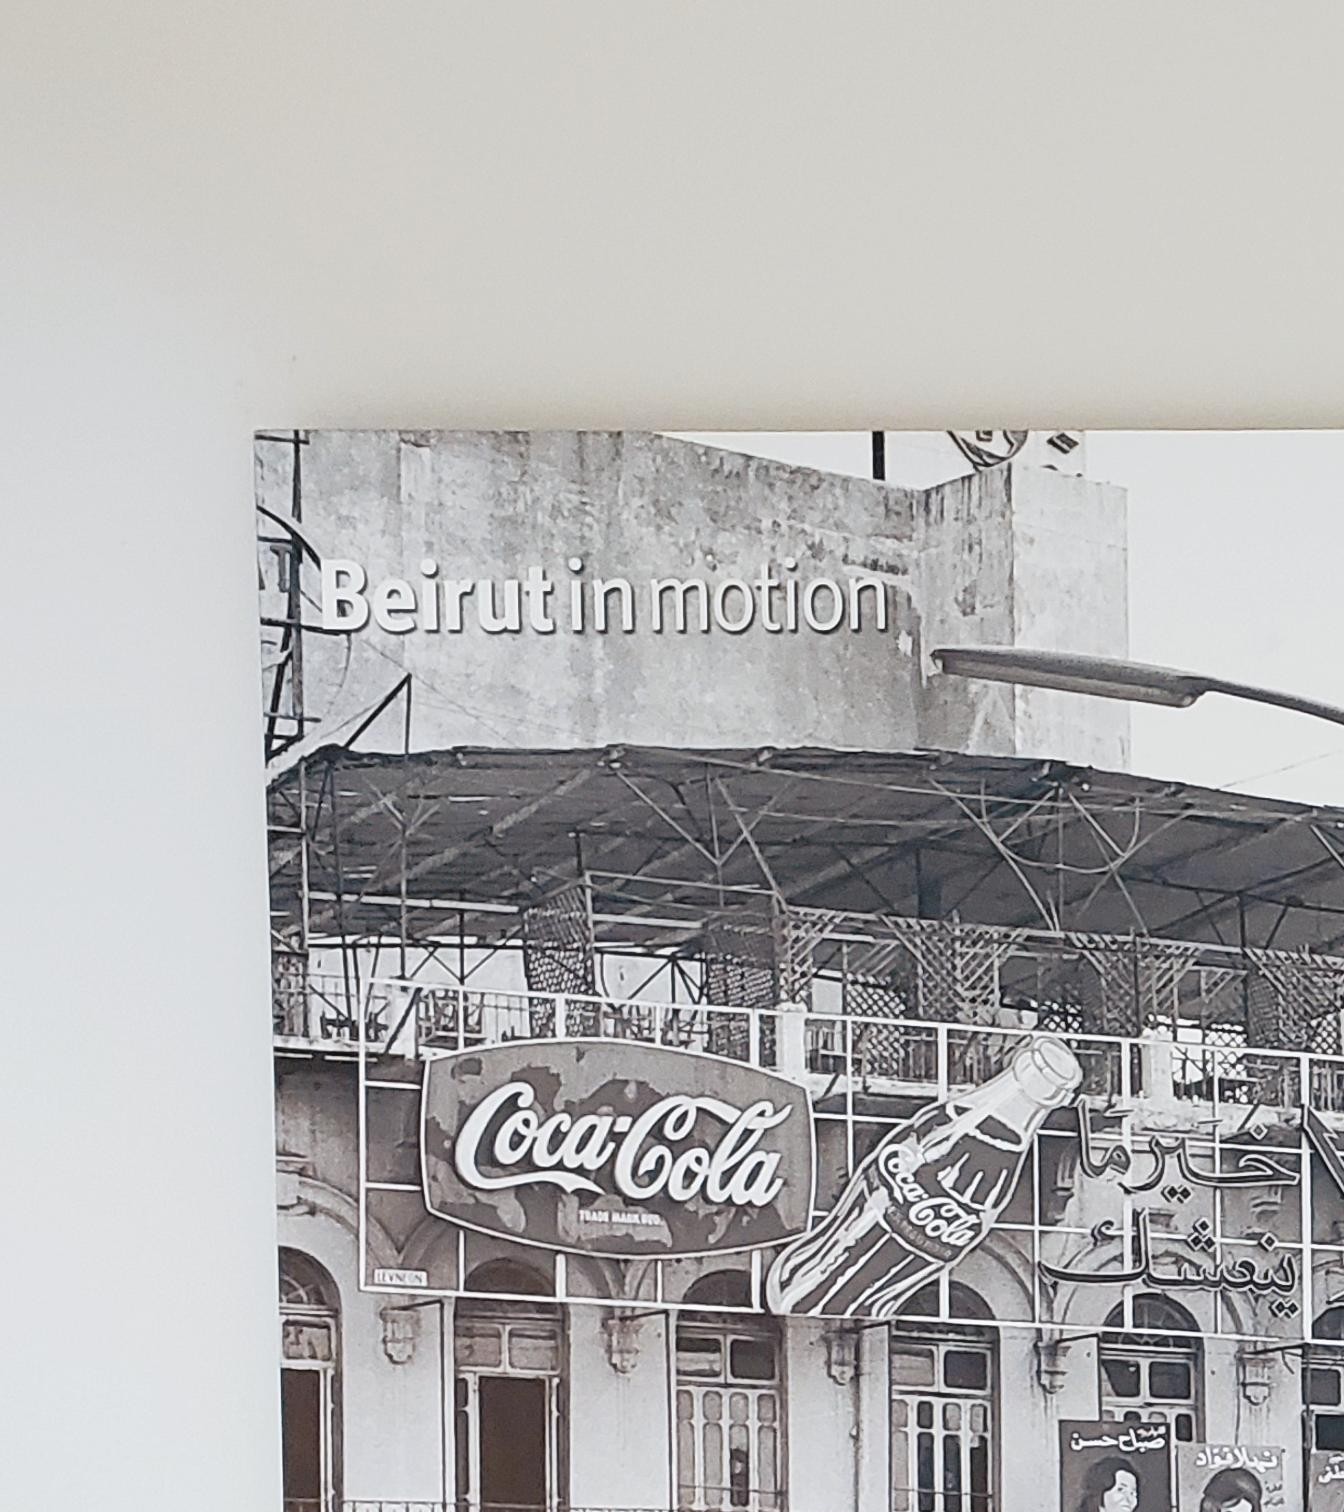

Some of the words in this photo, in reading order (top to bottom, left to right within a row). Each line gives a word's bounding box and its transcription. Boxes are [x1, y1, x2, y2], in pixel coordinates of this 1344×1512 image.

[320, 557, 554, 634] Beirut
[568, 557, 635, 634] in
[650, 556, 890, 635] motion
[455, 1081, 793, 1208] Coca-Cola
